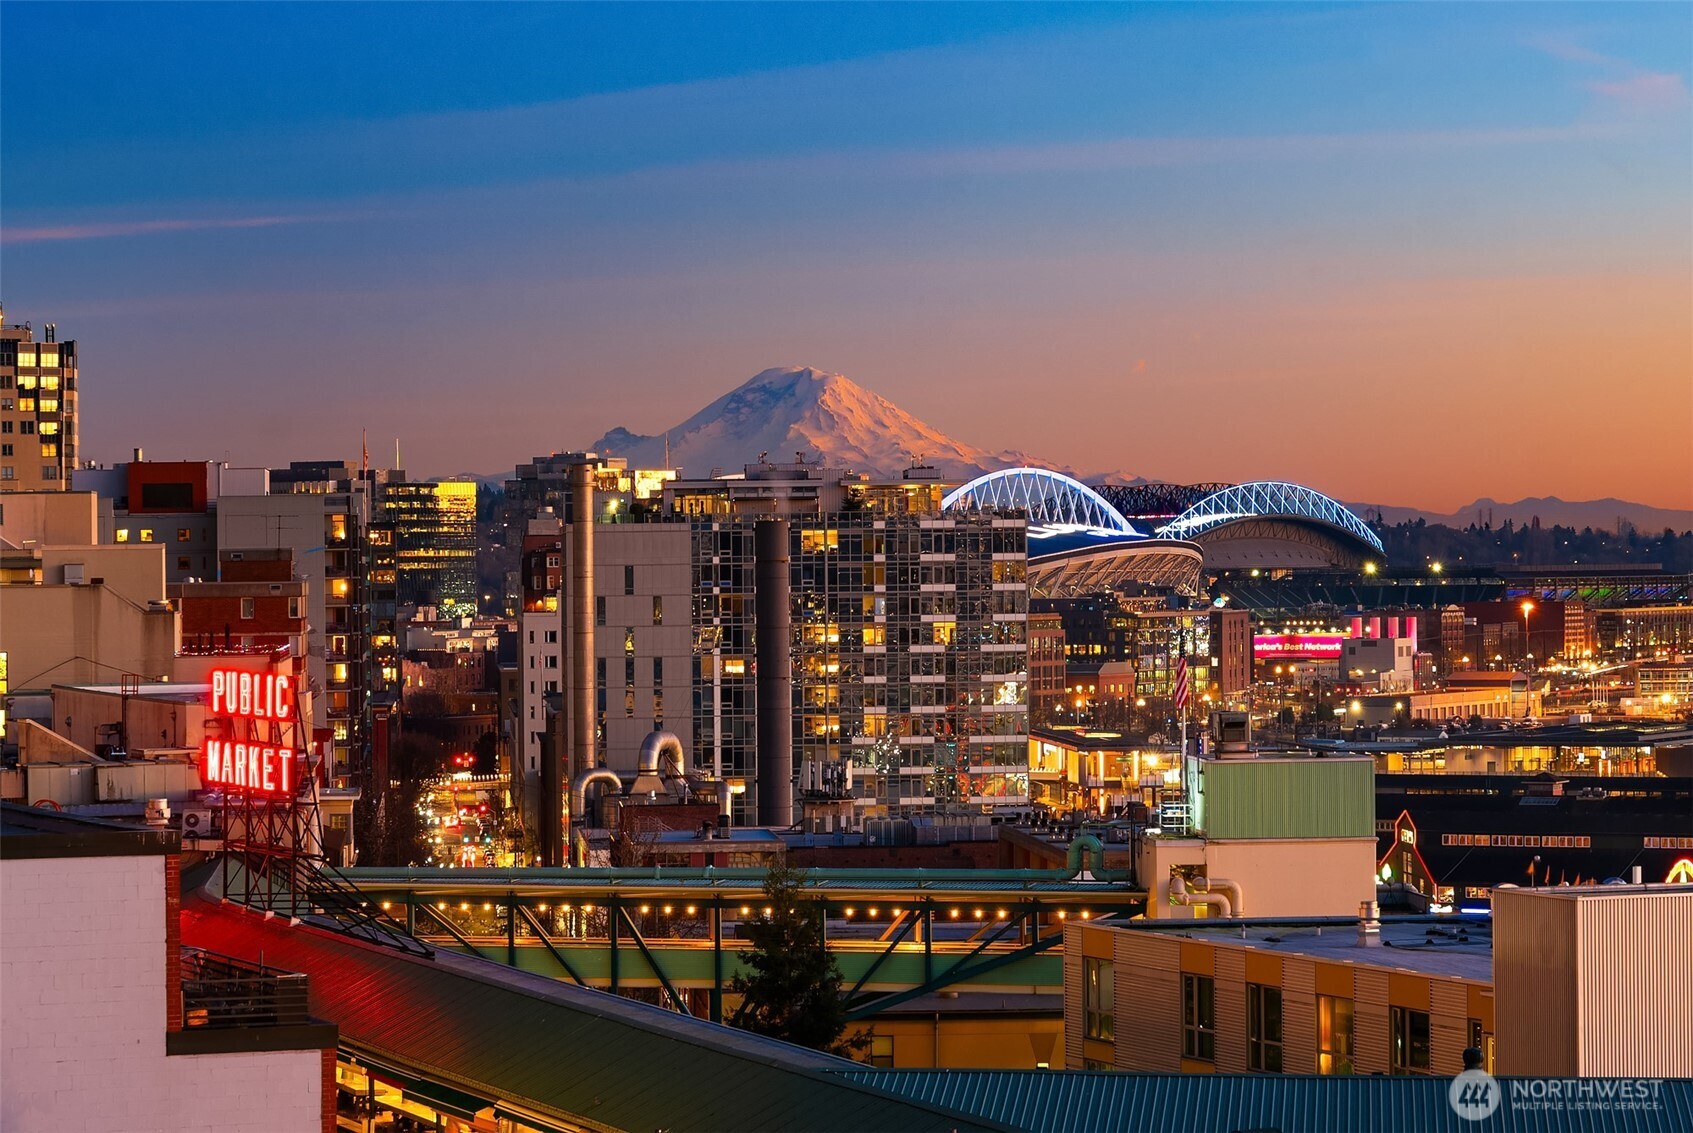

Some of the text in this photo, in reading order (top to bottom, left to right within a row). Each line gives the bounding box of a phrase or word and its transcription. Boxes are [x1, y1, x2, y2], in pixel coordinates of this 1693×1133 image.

[1254, 643, 1341, 651] erica's Best Network
[213, 671, 288, 717] PUBLIC
[207, 740, 292, 791] MARKET
